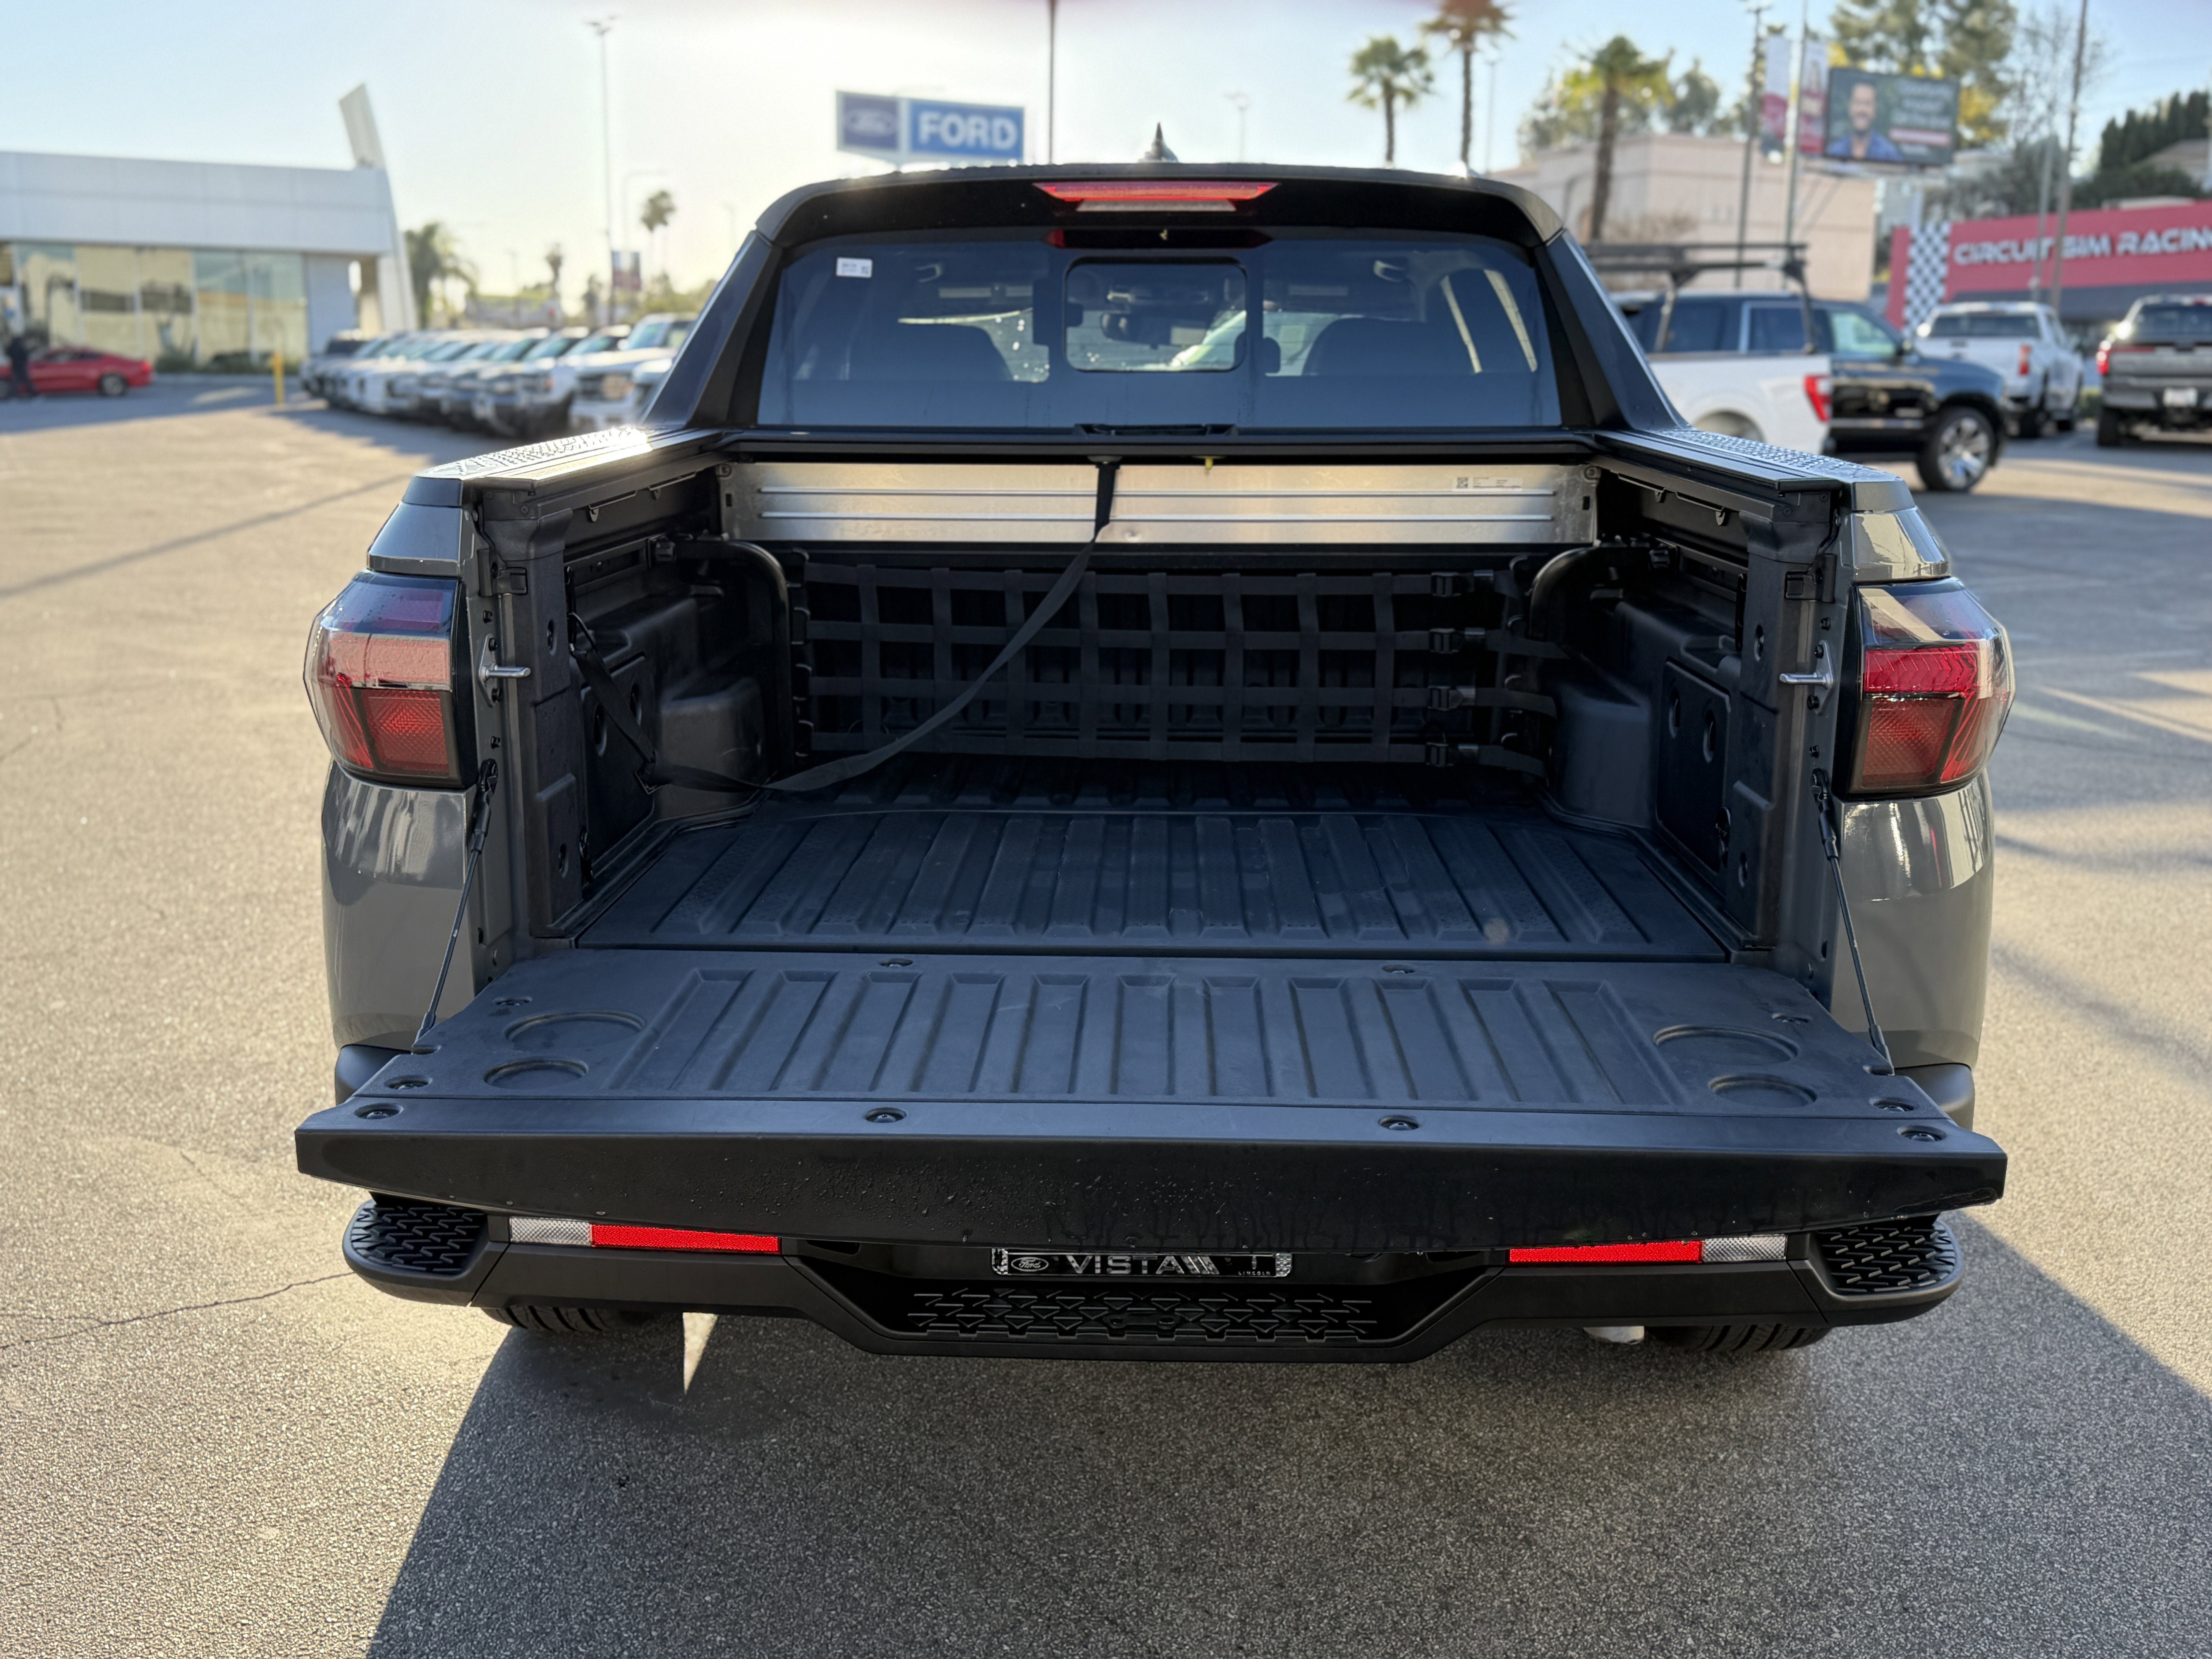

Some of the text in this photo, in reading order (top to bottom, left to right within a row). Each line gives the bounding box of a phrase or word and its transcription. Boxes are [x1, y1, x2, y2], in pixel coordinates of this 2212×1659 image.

[919, 112, 1018, 150] FORD
[1953, 237, 2056, 265] CIRCUIT
[2117, 226, 2212, 256] RACIN
[1018, 1254, 1185, 1274] Ford VISTA
